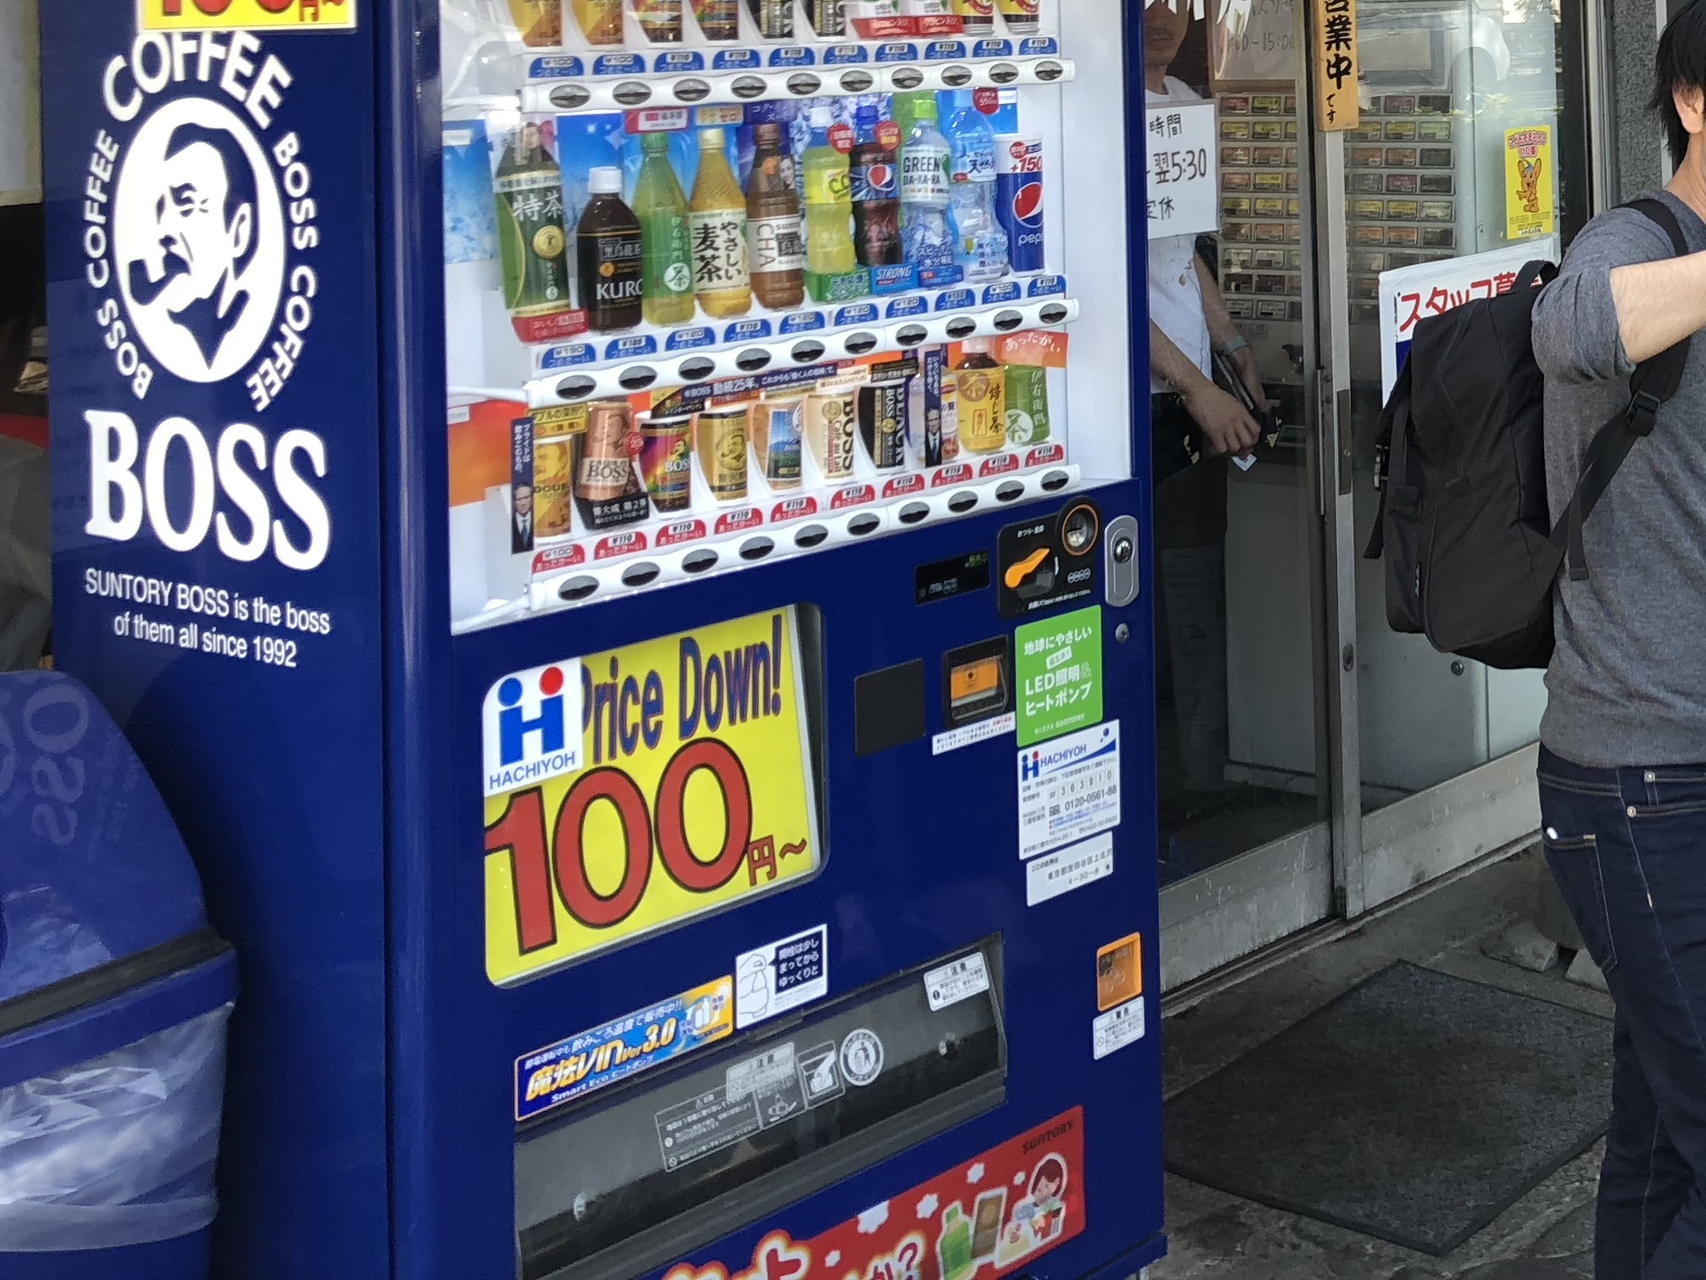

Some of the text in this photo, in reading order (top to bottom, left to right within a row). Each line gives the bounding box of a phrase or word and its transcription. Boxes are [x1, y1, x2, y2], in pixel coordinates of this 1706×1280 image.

[104, 31, 293, 129] COFFEE
[1150, 114, 1182, 138] 時間
[1326, 93, 1336, 124] です
[903, 156, 941, 173] GREEN
[512, 192, 562, 221] 特茶
[84, 129, 155, 400] BOSS COFFEE
[693, 224, 722, 283] 麦茶
[720, 222, 742, 282] やさしい
[758, 224, 776, 269] CHA
[246, 131, 320, 412] BOSS COFFEE
[886, 389, 895, 417] BOSS
[83, 410, 330, 571] BOSS
[85, 567, 331, 635] SUNTORY BOSS is the boss
[114, 613, 297, 667] of them all since 1992
[1024, 626, 1092, 656] 地球にやさしい
[679, 614, 782, 741] Down!
[1025, 664, 1080, 696] LED照明
[1025, 681, 1092, 717] ヒートポンプ
[489, 751, 576, 790] HACHIYOH
[1040, 744, 1087, 768] HACHIYOH
[779, 952, 819, 974] まってから
[779, 966, 819, 988] ゆっくりと
[1021, 1119, 1074, 1154] SUNTORY
